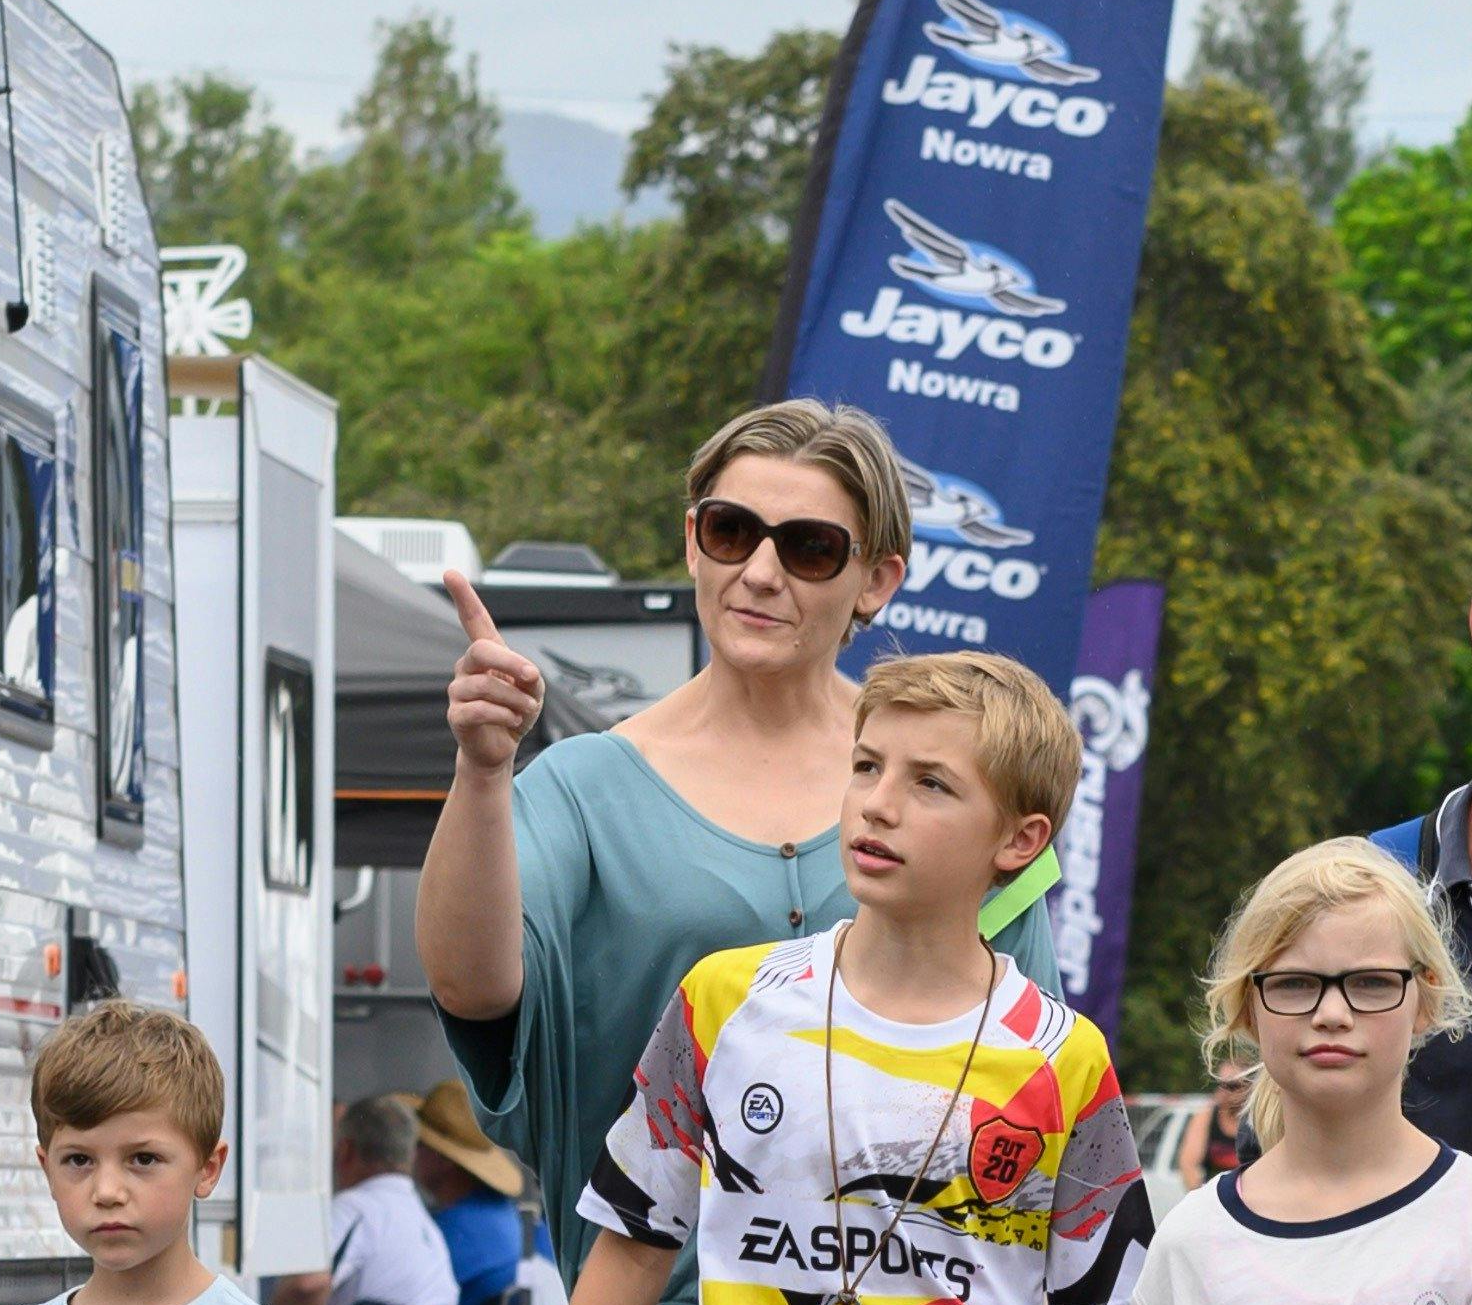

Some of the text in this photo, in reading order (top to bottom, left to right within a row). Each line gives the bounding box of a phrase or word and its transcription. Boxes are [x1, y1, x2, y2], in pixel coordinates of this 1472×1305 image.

[882, 54, 1109, 137] Jayco
[920, 127, 1053, 181] Nowra
[840, 287, 1076, 369] Jayco
[887, 359, 1020, 413] Nowra
[901, 541, 1041, 600] yco
[747, 1094, 775, 1113] EA
[747, 1111, 778, 1122] SPORTS
[982, 1158, 1018, 1185] 20
[991, 1135, 1027, 1160] FUT
[738, 1216, 809, 1271] EA
